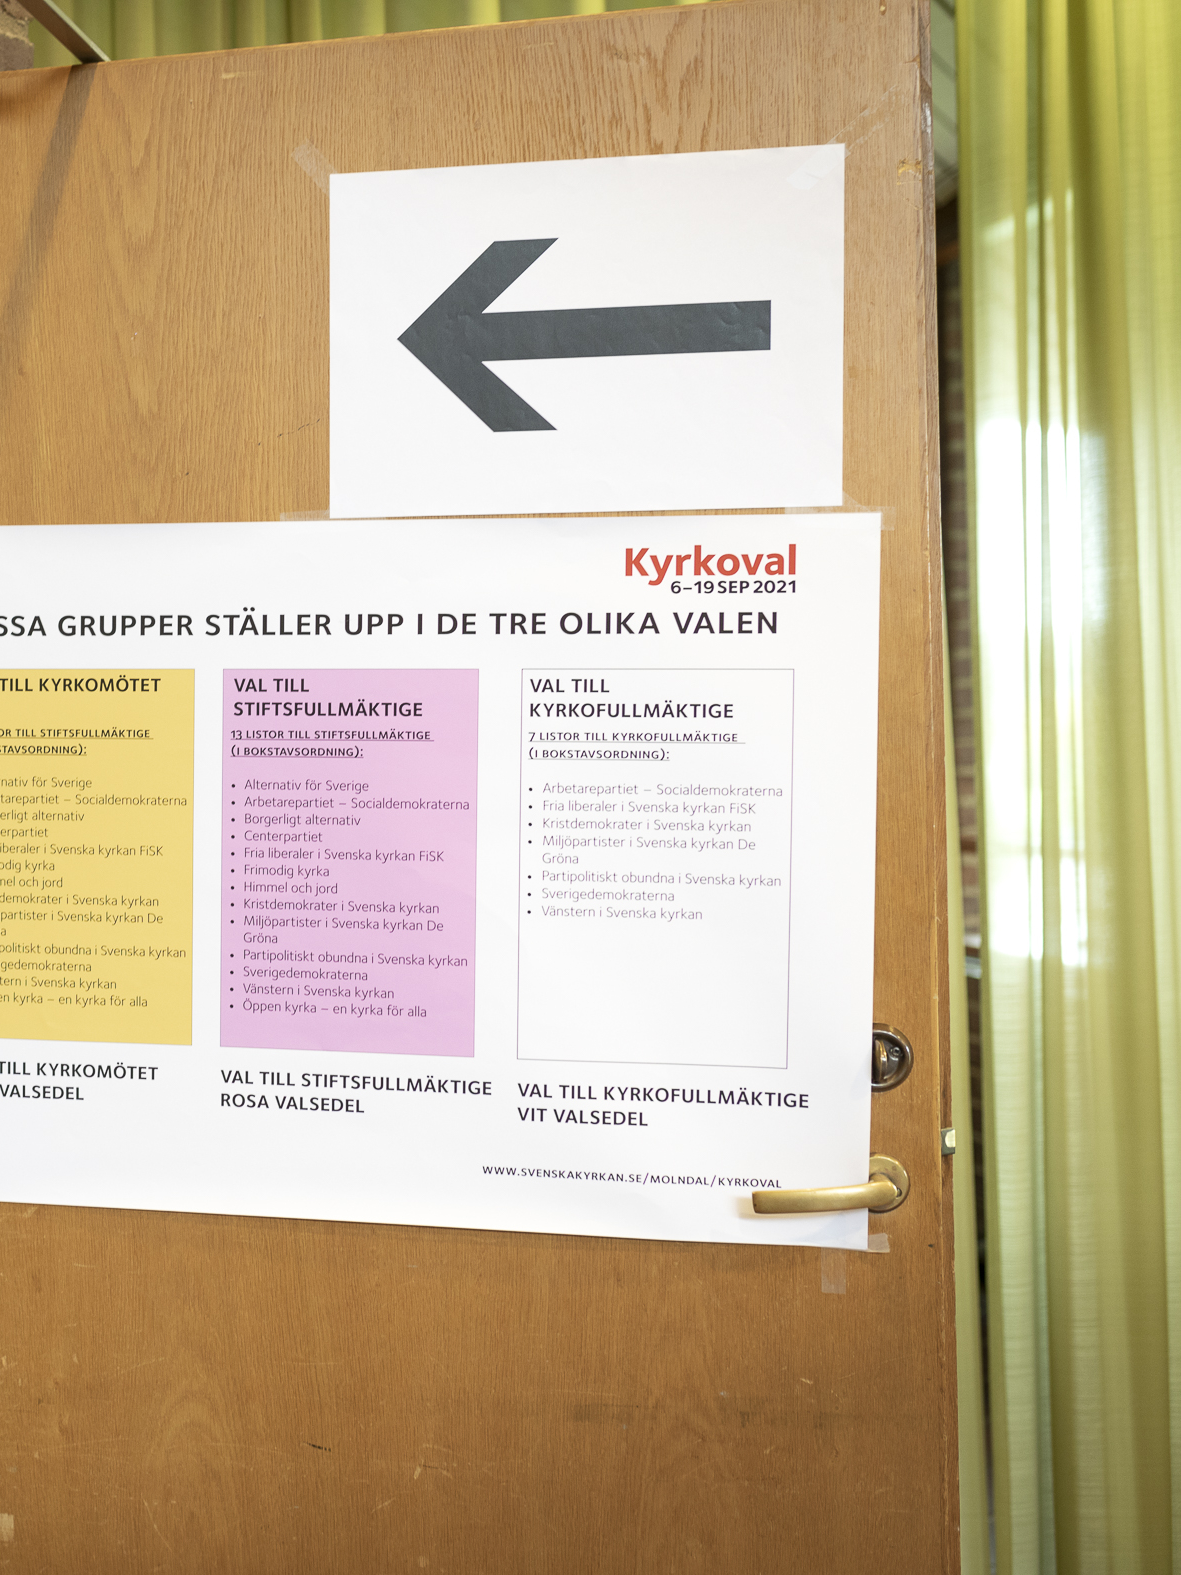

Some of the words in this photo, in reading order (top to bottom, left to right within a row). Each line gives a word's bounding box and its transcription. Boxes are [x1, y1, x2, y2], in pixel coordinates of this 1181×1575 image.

[625, 544, 797, 586] Kyrkoval
[670, 580, 715, 594] 6–19
[717, 580, 750, 594] SEP
[753, 580, 796, 594] 2021
[57, 614, 194, 637] GRUPPER
[205, 606, 332, 636] STÄLLER
[344, 613, 404, 636] UPP
[417, 613, 423, 635] I
[437, 613, 477, 635] DE
[489, 612, 547, 635] TRE
[559, 612, 660, 635] OLIKA
[672, 611, 777, 634] VALEN
[39, 674, 161, 692] KYRKOMÖTET
[233, 678, 268, 692] VAL
[272, 678, 310, 693] TILL
[529, 678, 565, 693] VAL
[571, 678, 610, 693] TILL
[233, 698, 423, 717] STIFTSFULLMÄKTIGE
[529, 700, 734, 719] KYRKOFULLMÄKTIGE
[15, 728, 37, 738] TILL
[39, 726, 151, 739] STIFTSFULLMÄKTIGE
[230, 730, 243, 741] 13
[246, 730, 284, 739] LISTOR
[288, 730, 311, 739] TILL
[314, 728, 430, 740] STIFTSFULLMÄKTIGE
[527, 731, 536, 743] 7
[539, 732, 580, 741] LISTOR
[583, 731, 609, 742] TILL
[612, 730, 738, 742] KYRKOFULLMÄKTIGE
[231, 744, 240, 757] (I
[243, 745, 363, 758] BOKSTAVSORDNING):
[528, 746, 538, 760] (I
[542, 748, 669, 761] BOKSTAVSORDNING):
[31, 775, 48, 788] för
[51, 776, 93, 792] Sverige
[244, 778, 302, 791] Alternativ
[305, 778, 322, 791] för
[325, 779, 369, 795] Sverige
[542, 782, 639, 797] Arbetarepartiet
[656, 783, 783, 797] Socialdemokraterna
[75, 793, 187, 807] Socialdemokraterna
[243, 795, 335, 811] Arbetarepartiet
[351, 797, 470, 811] Socialdemokraterna
[31, 809, 85, 822] alternativ
[244, 812, 302, 828] Borgerligt
[304, 813, 361, 826] alternativ
[542, 817, 643, 831] Kristdemokrater
[653, 818, 705, 832] Svenska
[708, 819, 752, 835] kyrkan
[244, 829, 323, 845] Centerpartiet
[49, 843, 95, 856] Svenska
[98, 844, 136, 859] kyrkan
[139, 845, 164, 857] FiSK
[24, 859, 55, 874] kyrka
[244, 864, 294, 880] Frimodig
[297, 864, 330, 880] kyrka
[18, 876, 39, 888] och
[40, 876, 63, 891] jord
[243, 881, 288, 893] Himmel
[290, 881, 313, 894] och
[314, 882, 338, 897] jord
[541, 887, 675, 903] Sverigedemokraterna
[243, 898, 338, 912] Kristdemokrater
[347, 900, 396, 913] Svenska
[399, 901, 440, 917] kyrkan
[541, 905, 596, 918] Vänstern
[606, 906, 657, 919] Svenska
[660, 907, 703, 923] kyrkan
[57, 910, 103, 923] Svenska
[105, 911, 144, 926] kyrkan
[147, 912, 164, 924] De
[243, 948, 315, 964] Partipolitiskt
[317, 950, 368, 964] obundna
[377, 952, 425, 966] Svenska
[428, 954, 468, 969] kyrkan
[243, 965, 368, 981] Sverigedemokraterna
[30, 976, 76, 989] Svenska
[79, 977, 117, 992] kyrkan
[242, 982, 294, 996] Vänstern
[303, 984, 351, 998] Svenska
[354, 986, 395, 1002] kyrkan
[13, 991, 43, 1007] kyrka
[58, 996, 72, 1005] en
[75, 993, 107, 1009] kyrka
[109, 994, 126, 1007] för
[129, 995, 148, 1008] alla
[242, 998, 282, 1014] Öppen
[284, 1000, 317, 1016] kyrka
[332, 1005, 347, 1015] en
[350, 1003, 383, 1019] kyrka
[387, 1004, 404, 1017] för
[407, 1005, 427, 1018] alla
[37, 1062, 159, 1080] KYRKOMÖTET
[220, 1069, 254, 1085] VAL
[259, 1071, 296, 1086] TILL
[301, 1072, 492, 1096] STIFTSFULLMÄKTIGE
[0, 1084, 84, 1101] VALSEDEL
[517, 1082, 553, 1099] VAL
[558, 1084, 597, 1100] TILL
[604, 1086, 809, 1109] KYRKOFULLMÄKTIGE
[221, 1093, 269, 1109] ROSA
[275, 1095, 365, 1114] VALSEDEL
[517, 1107, 548, 1122] VIT
[553, 1108, 648, 1127] VALSEDEL
[482, 1166, 782, 1189] WWW.SVENSKAKYRKAN.SE/MOLNDAL/KYRKOVAL
